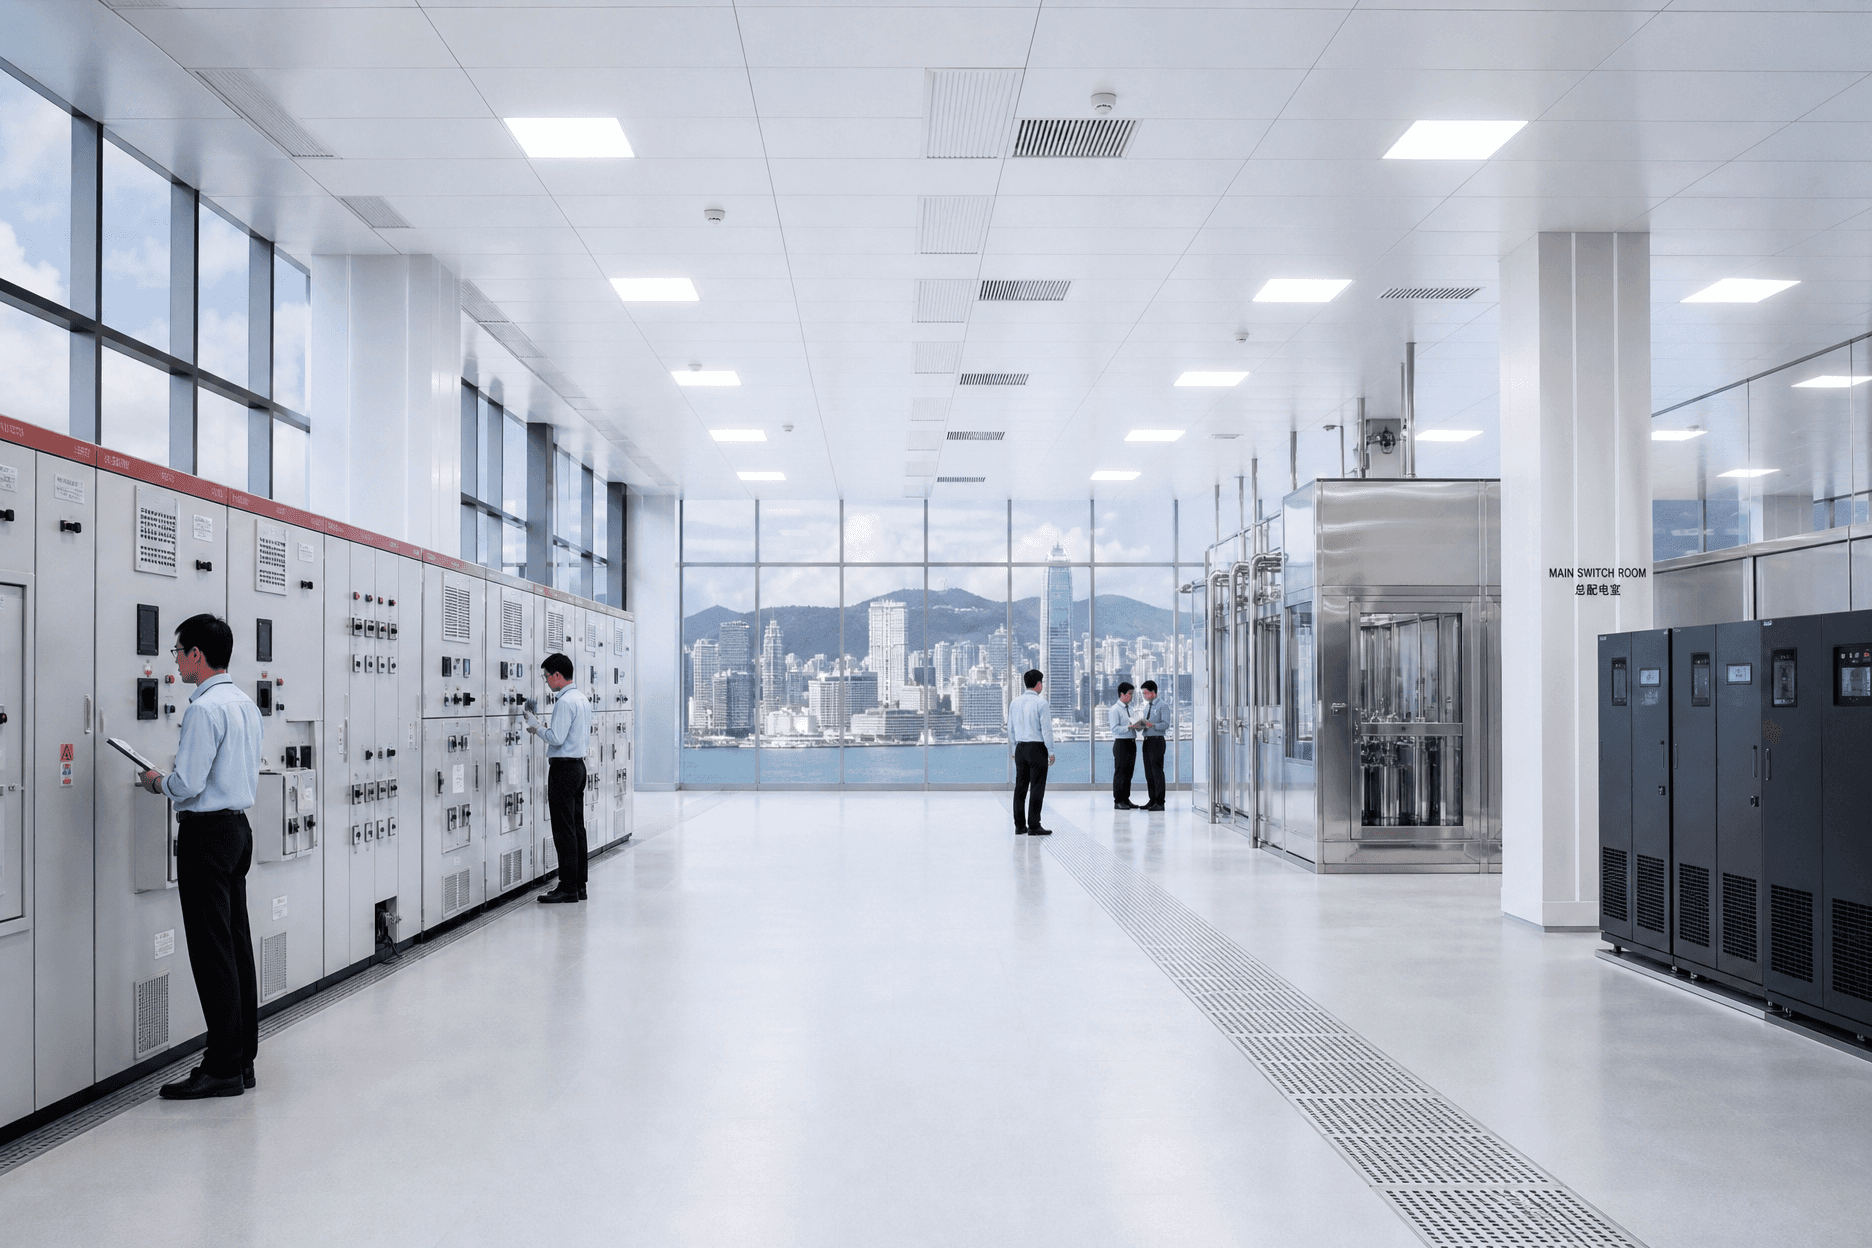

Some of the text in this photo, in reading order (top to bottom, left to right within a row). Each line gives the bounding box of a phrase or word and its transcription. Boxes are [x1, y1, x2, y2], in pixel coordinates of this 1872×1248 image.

[1549, 568, 1647, 578] MAIN SWITCH ROOM
